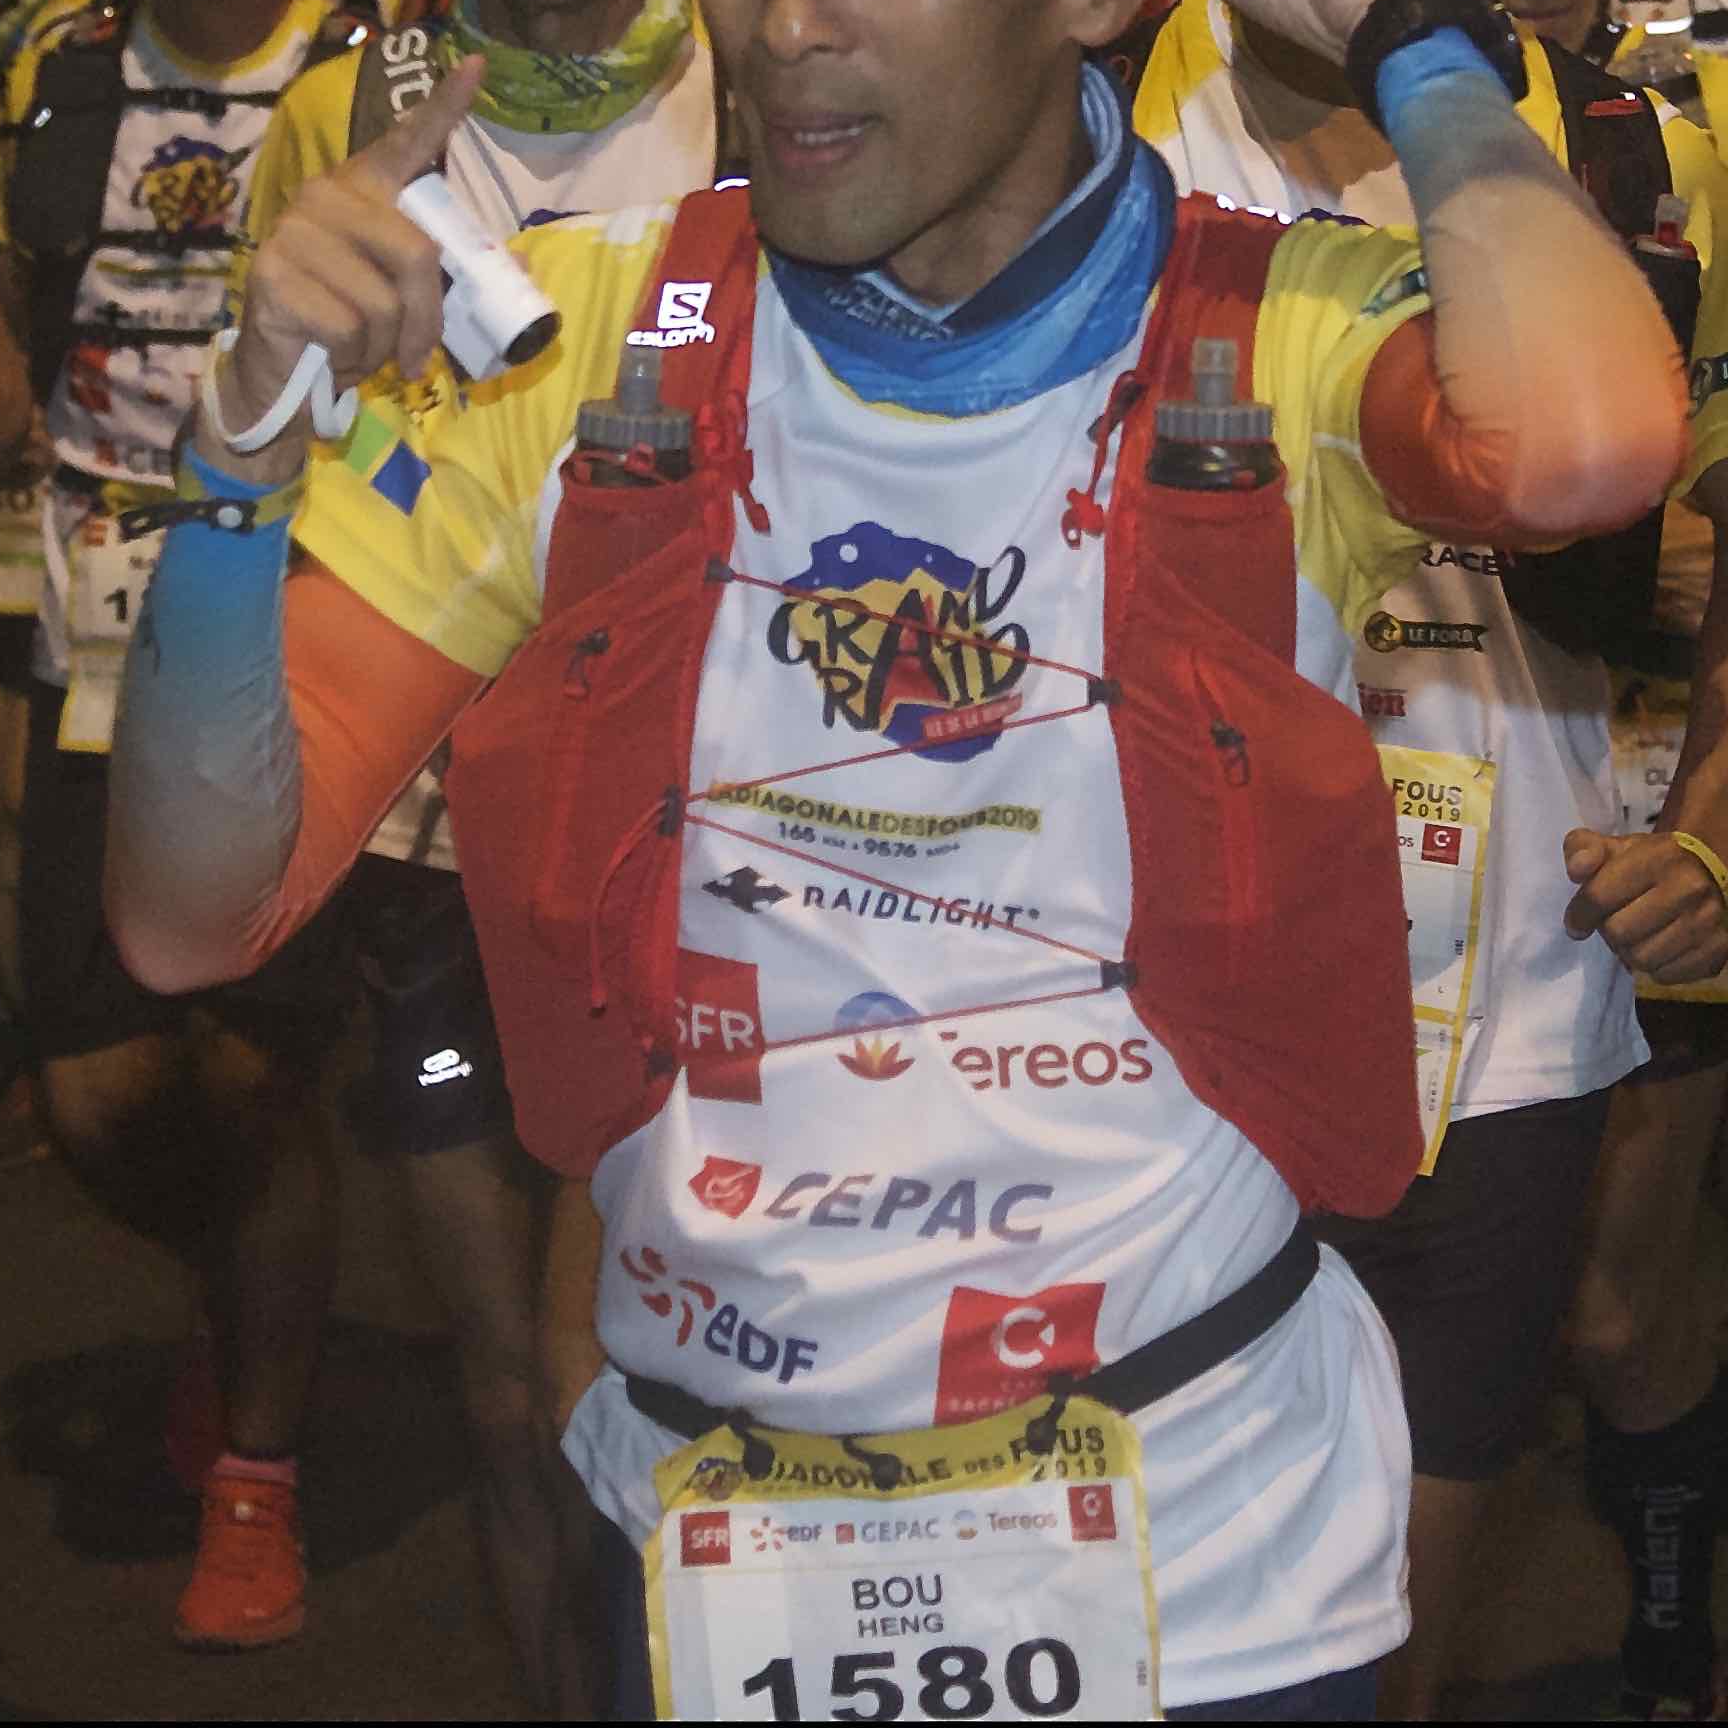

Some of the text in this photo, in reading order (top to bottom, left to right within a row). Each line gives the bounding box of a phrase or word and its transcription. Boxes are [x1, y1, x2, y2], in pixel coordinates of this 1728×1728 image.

[767, 544, 1026, 712] GRAND
[821, 592, 1031, 733] RAID
[1392, 778, 1463, 806] FOUS
[1401, 801, 1462, 822] 2019
[763, 1171, 1054, 1242] CEPAC
[1032, 1456, 1107, 1483] 2019
[689, 1529, 729, 1548] SFR
[860, 1521, 941, 1544] CEPAC
[987, 1510, 1058, 1533] Tereos
[851, 1574, 945, 1611] BOU
[857, 1613, 945, 1640] HENG
[743, 1637, 1081, 1722] 1580
